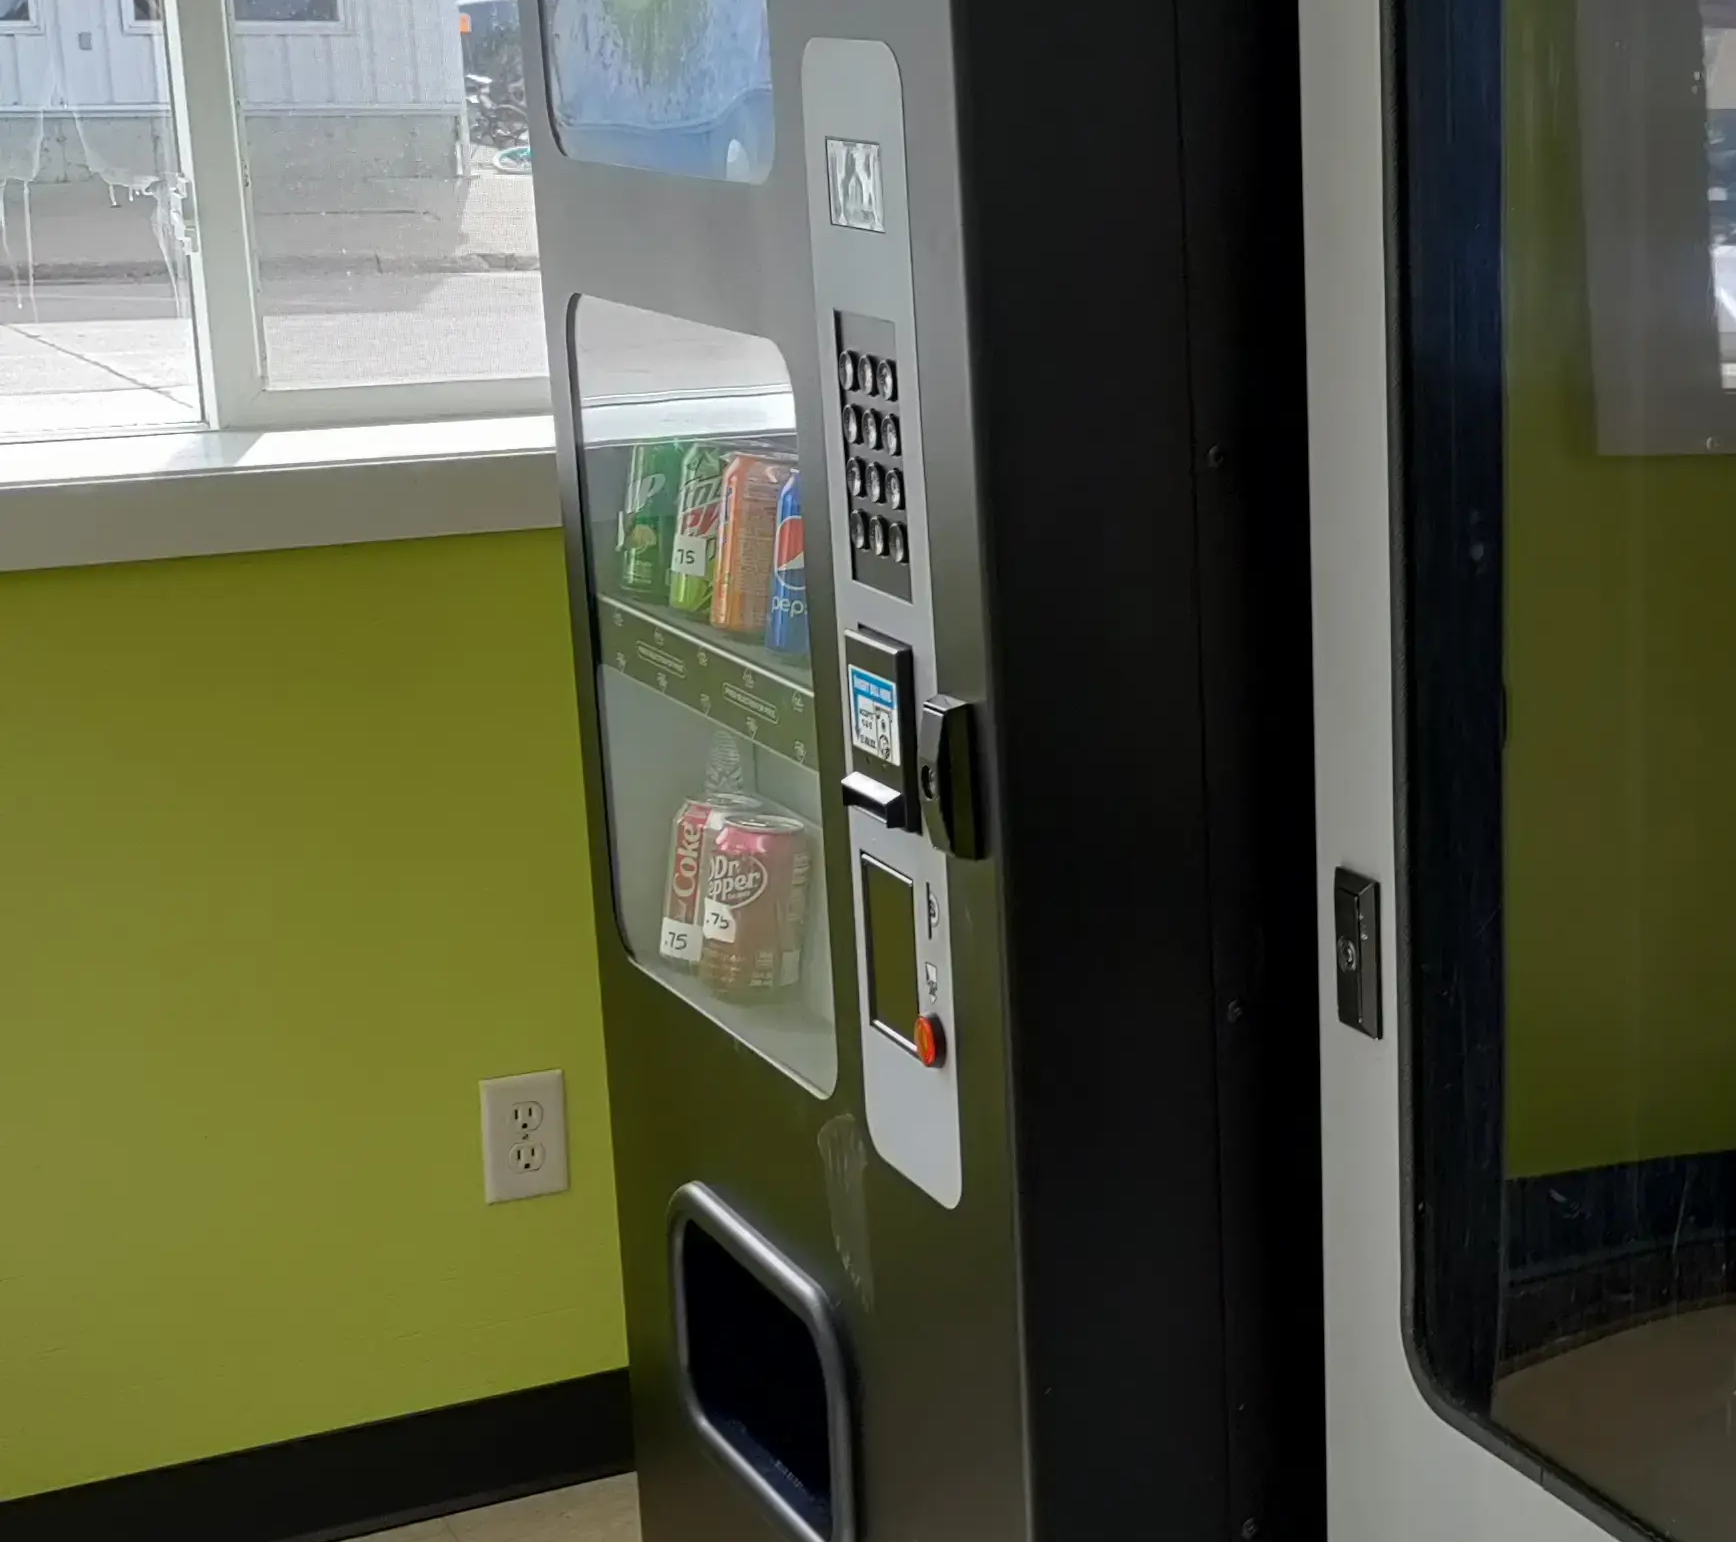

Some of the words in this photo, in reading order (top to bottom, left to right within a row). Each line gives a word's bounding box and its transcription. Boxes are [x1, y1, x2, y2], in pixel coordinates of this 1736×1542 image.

[771, 596, 808, 619] pep
[673, 821, 702, 898] Coke
[708, 861, 761, 901] epper
[705, 912, 730, 930] .75
[663, 930, 689, 951] .75
